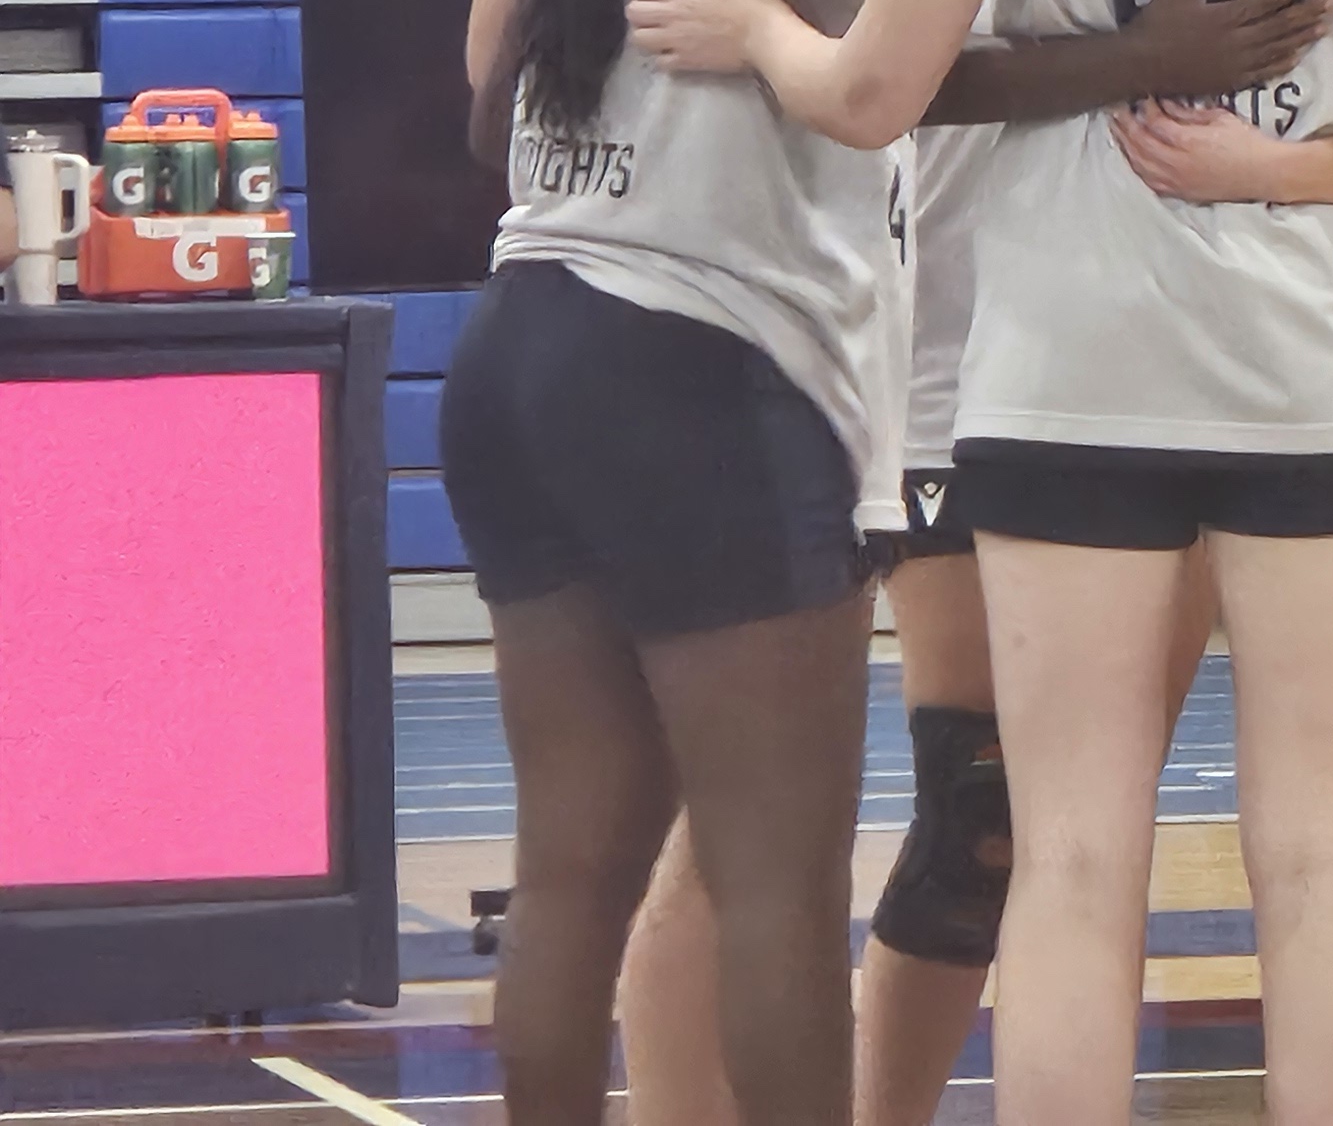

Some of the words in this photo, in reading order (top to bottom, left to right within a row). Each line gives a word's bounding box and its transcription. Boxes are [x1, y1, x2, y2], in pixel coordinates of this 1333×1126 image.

[112, 167, 145, 205] G
[238, 165, 271, 203] G
[172, 230, 219, 282] G
